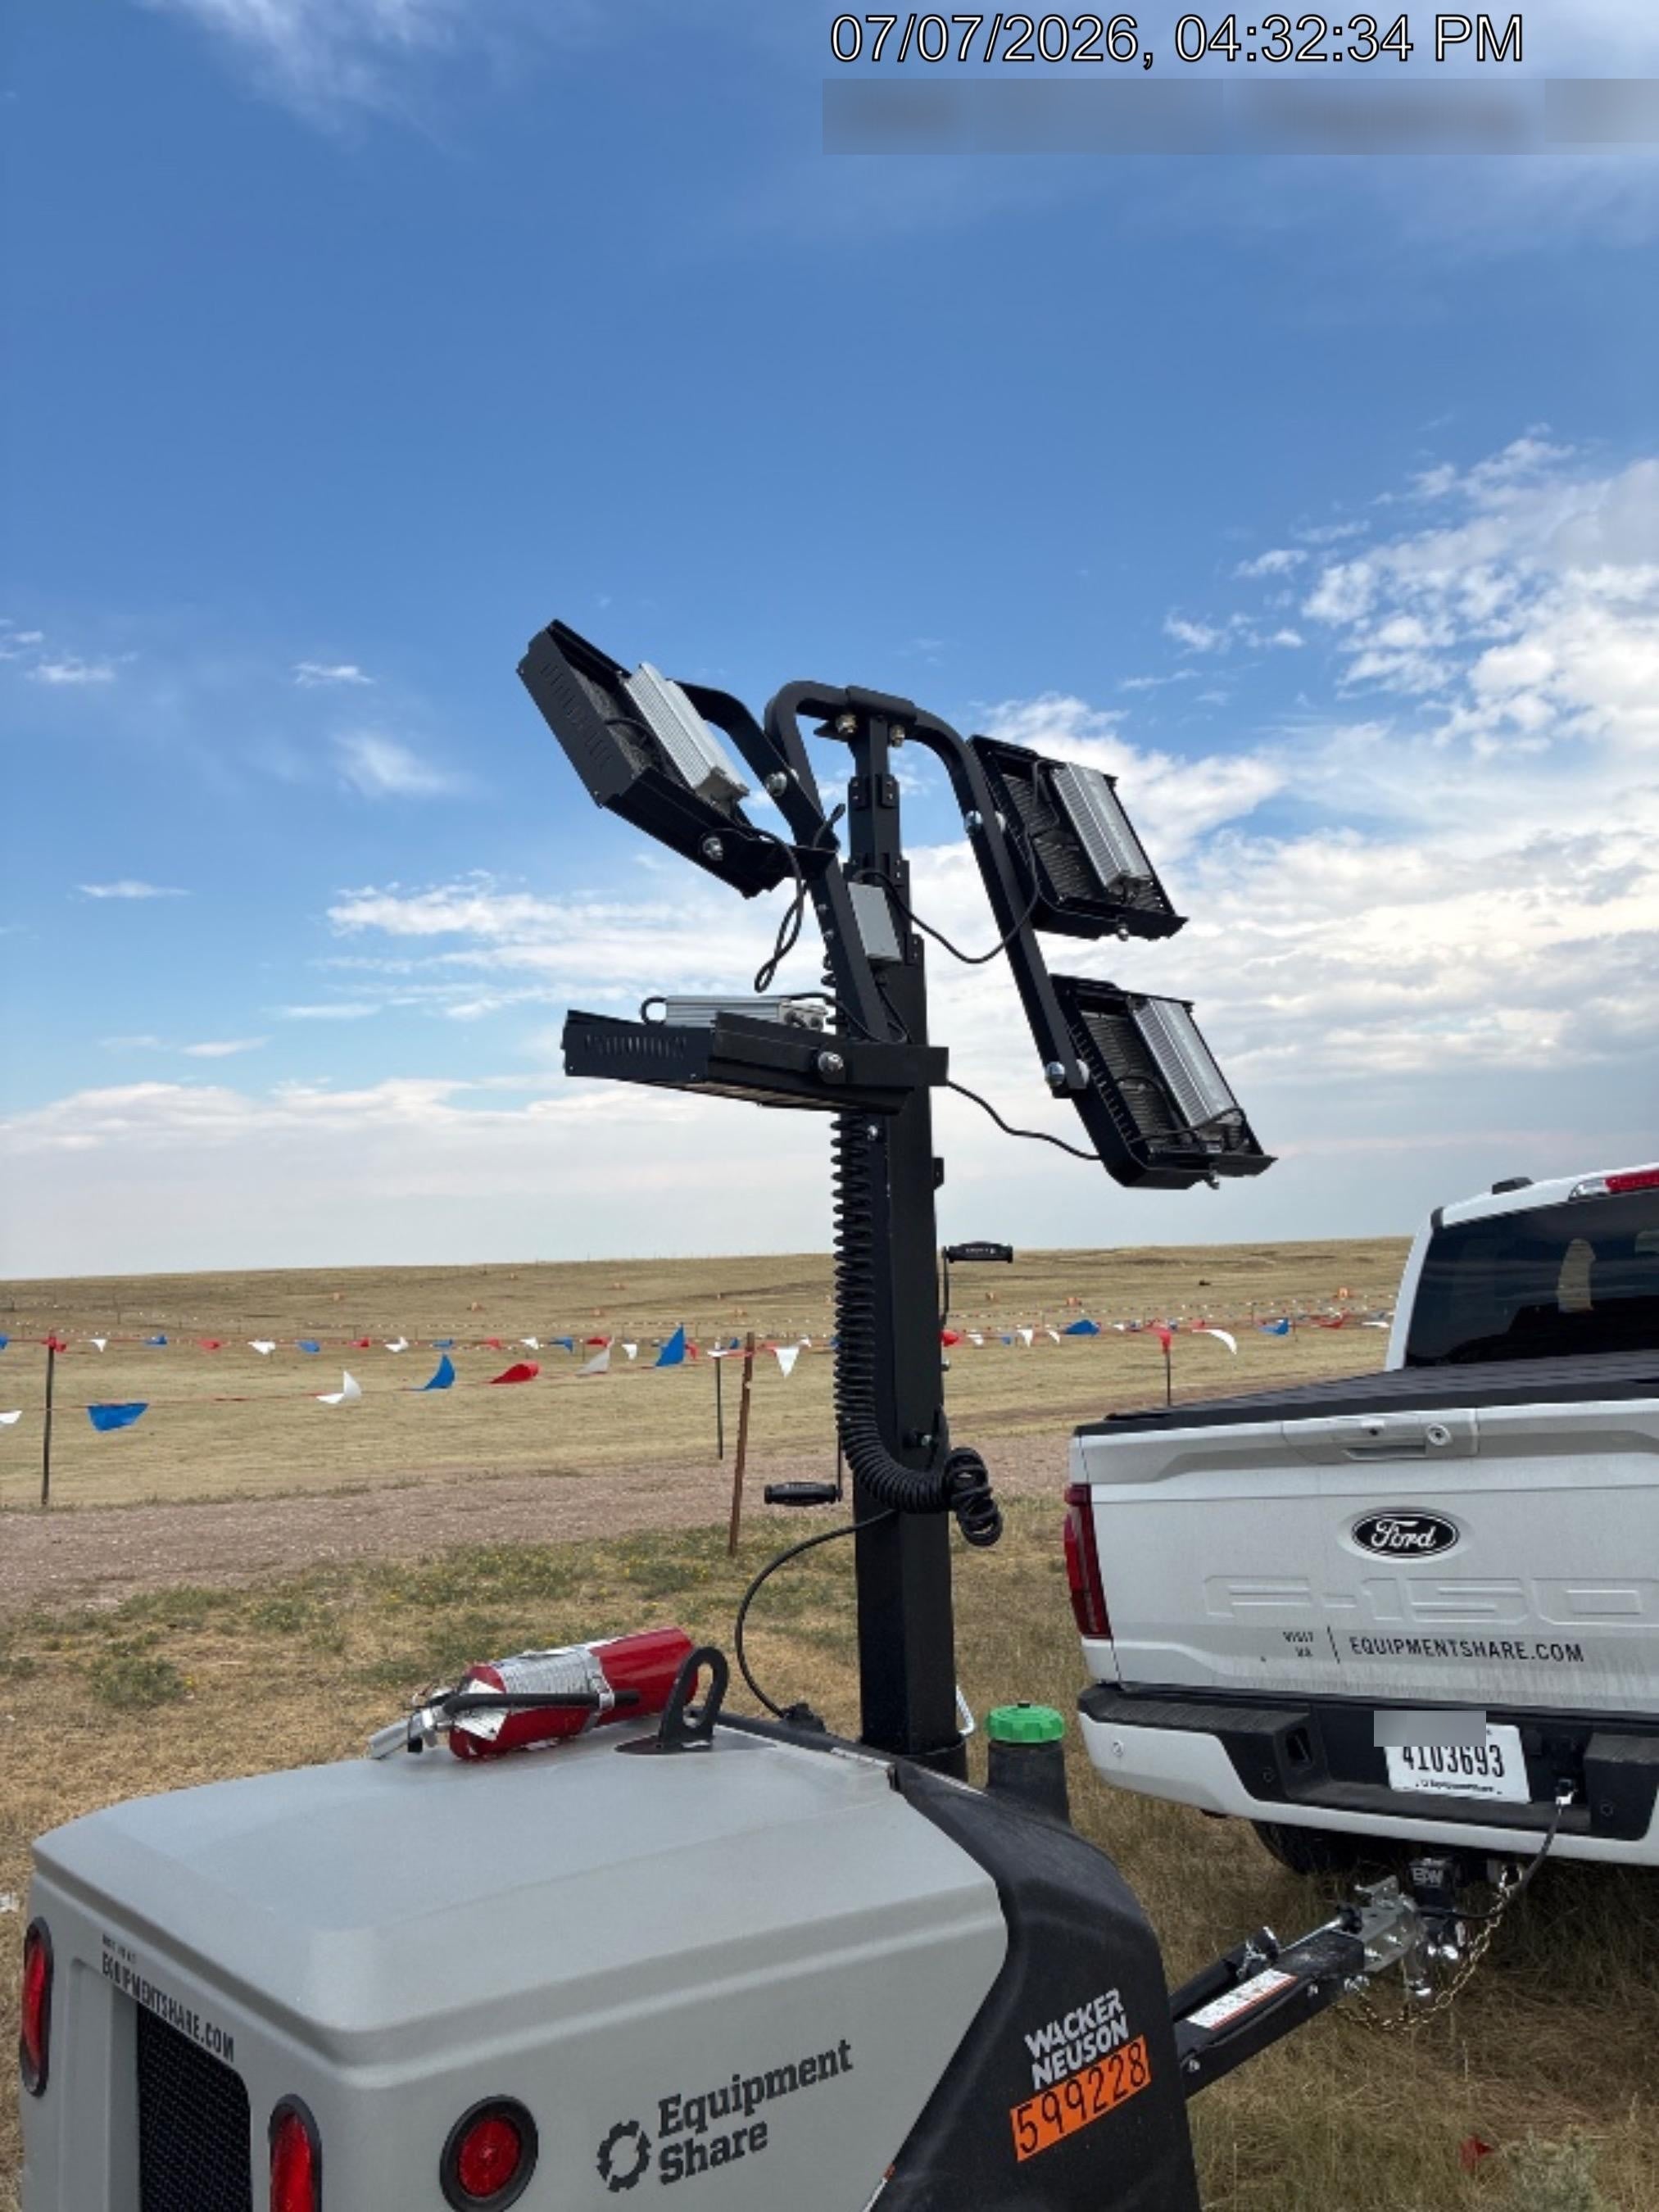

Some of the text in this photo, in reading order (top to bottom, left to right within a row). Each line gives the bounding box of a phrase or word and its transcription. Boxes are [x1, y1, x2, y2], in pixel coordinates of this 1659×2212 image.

[1371, 1518, 1437, 1548] Ford
[1203, 1575, 1659, 1628] F-150
[1349, 1636, 1584, 1662] EQUIPMENTSHARE.COM
[1402, 1743, 1506, 1778] 4103693
[102, 1951, 234, 2063] EQUIPMENTSHARE.COM
[1024, 1988, 1125, 2060] WACKER
[1031, 2013, 1130, 2090] NEUSON
[658, 2038, 854, 2138] Equipment
[1016, 2042, 1147, 2154] 599228
[658, 2120, 768, 2186] Share
